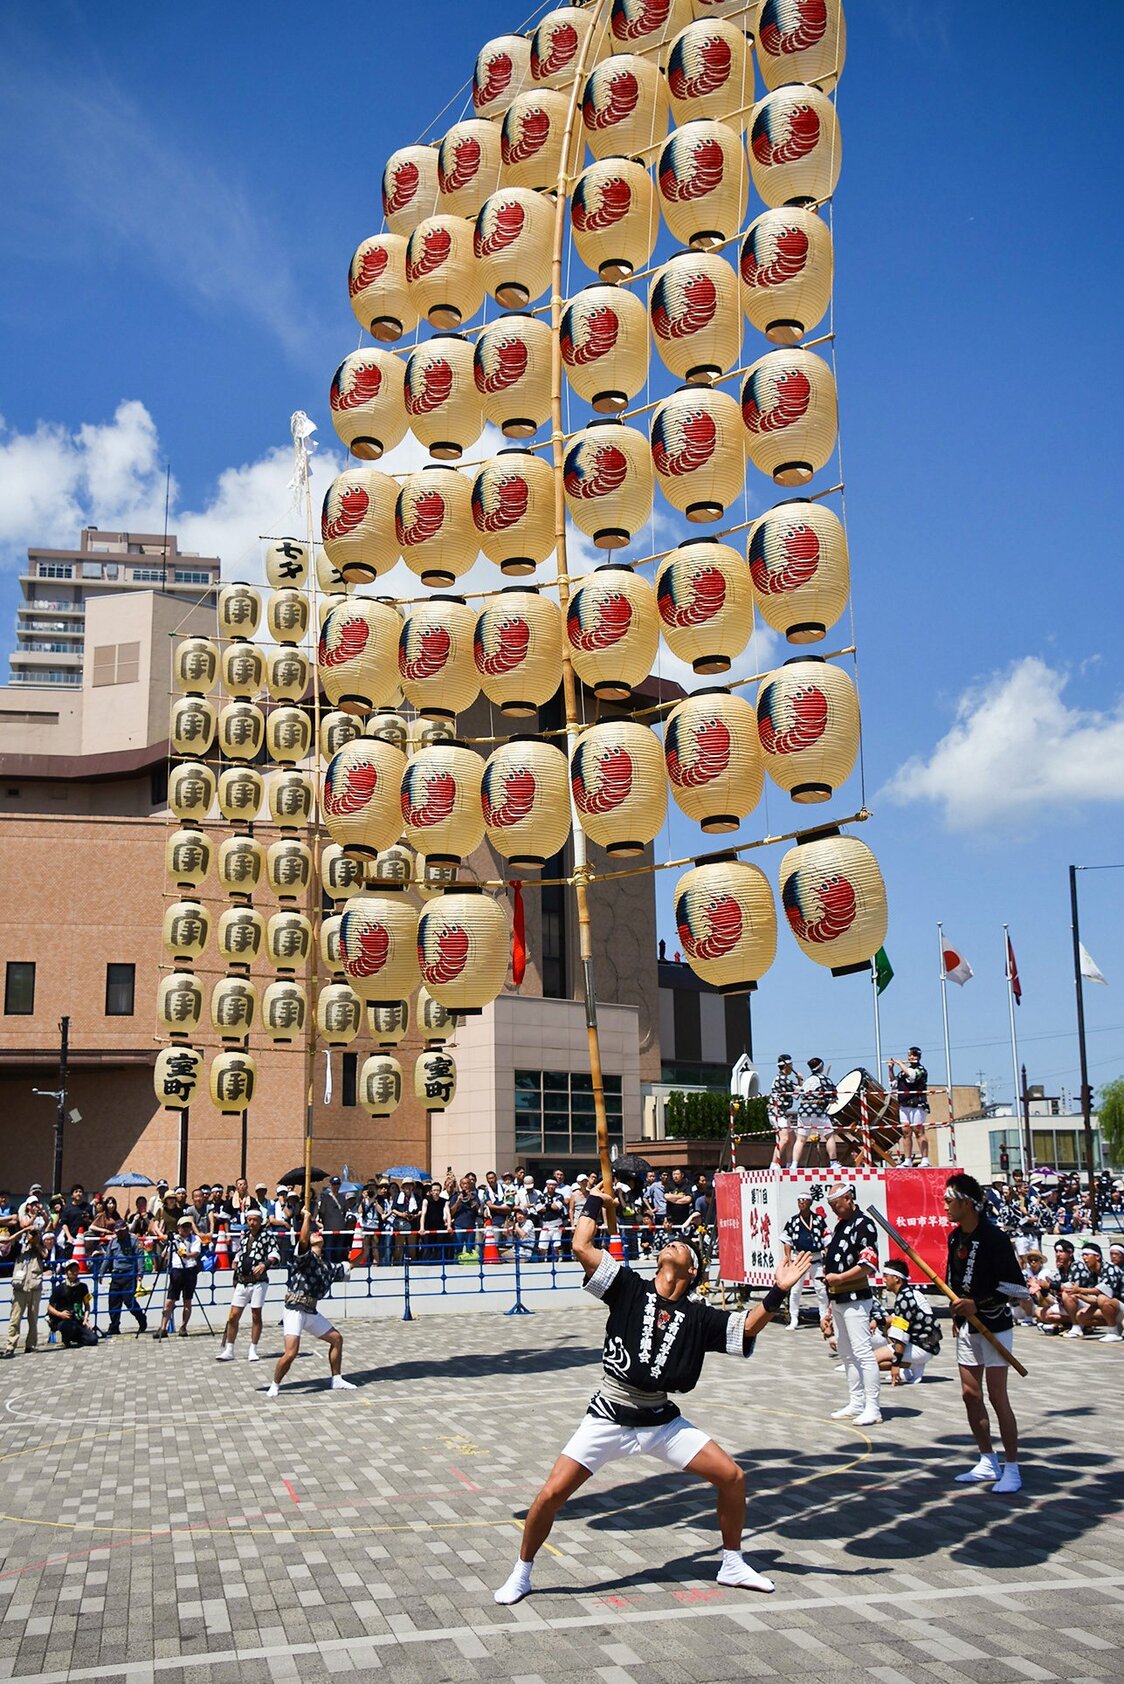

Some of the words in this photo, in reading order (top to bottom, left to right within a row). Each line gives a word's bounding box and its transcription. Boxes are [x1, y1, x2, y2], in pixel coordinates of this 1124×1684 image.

[275, 542, 303, 579] 七夕
[163, 1053, 199, 1102] 室町
[424, 1056, 454, 1102] 室町
